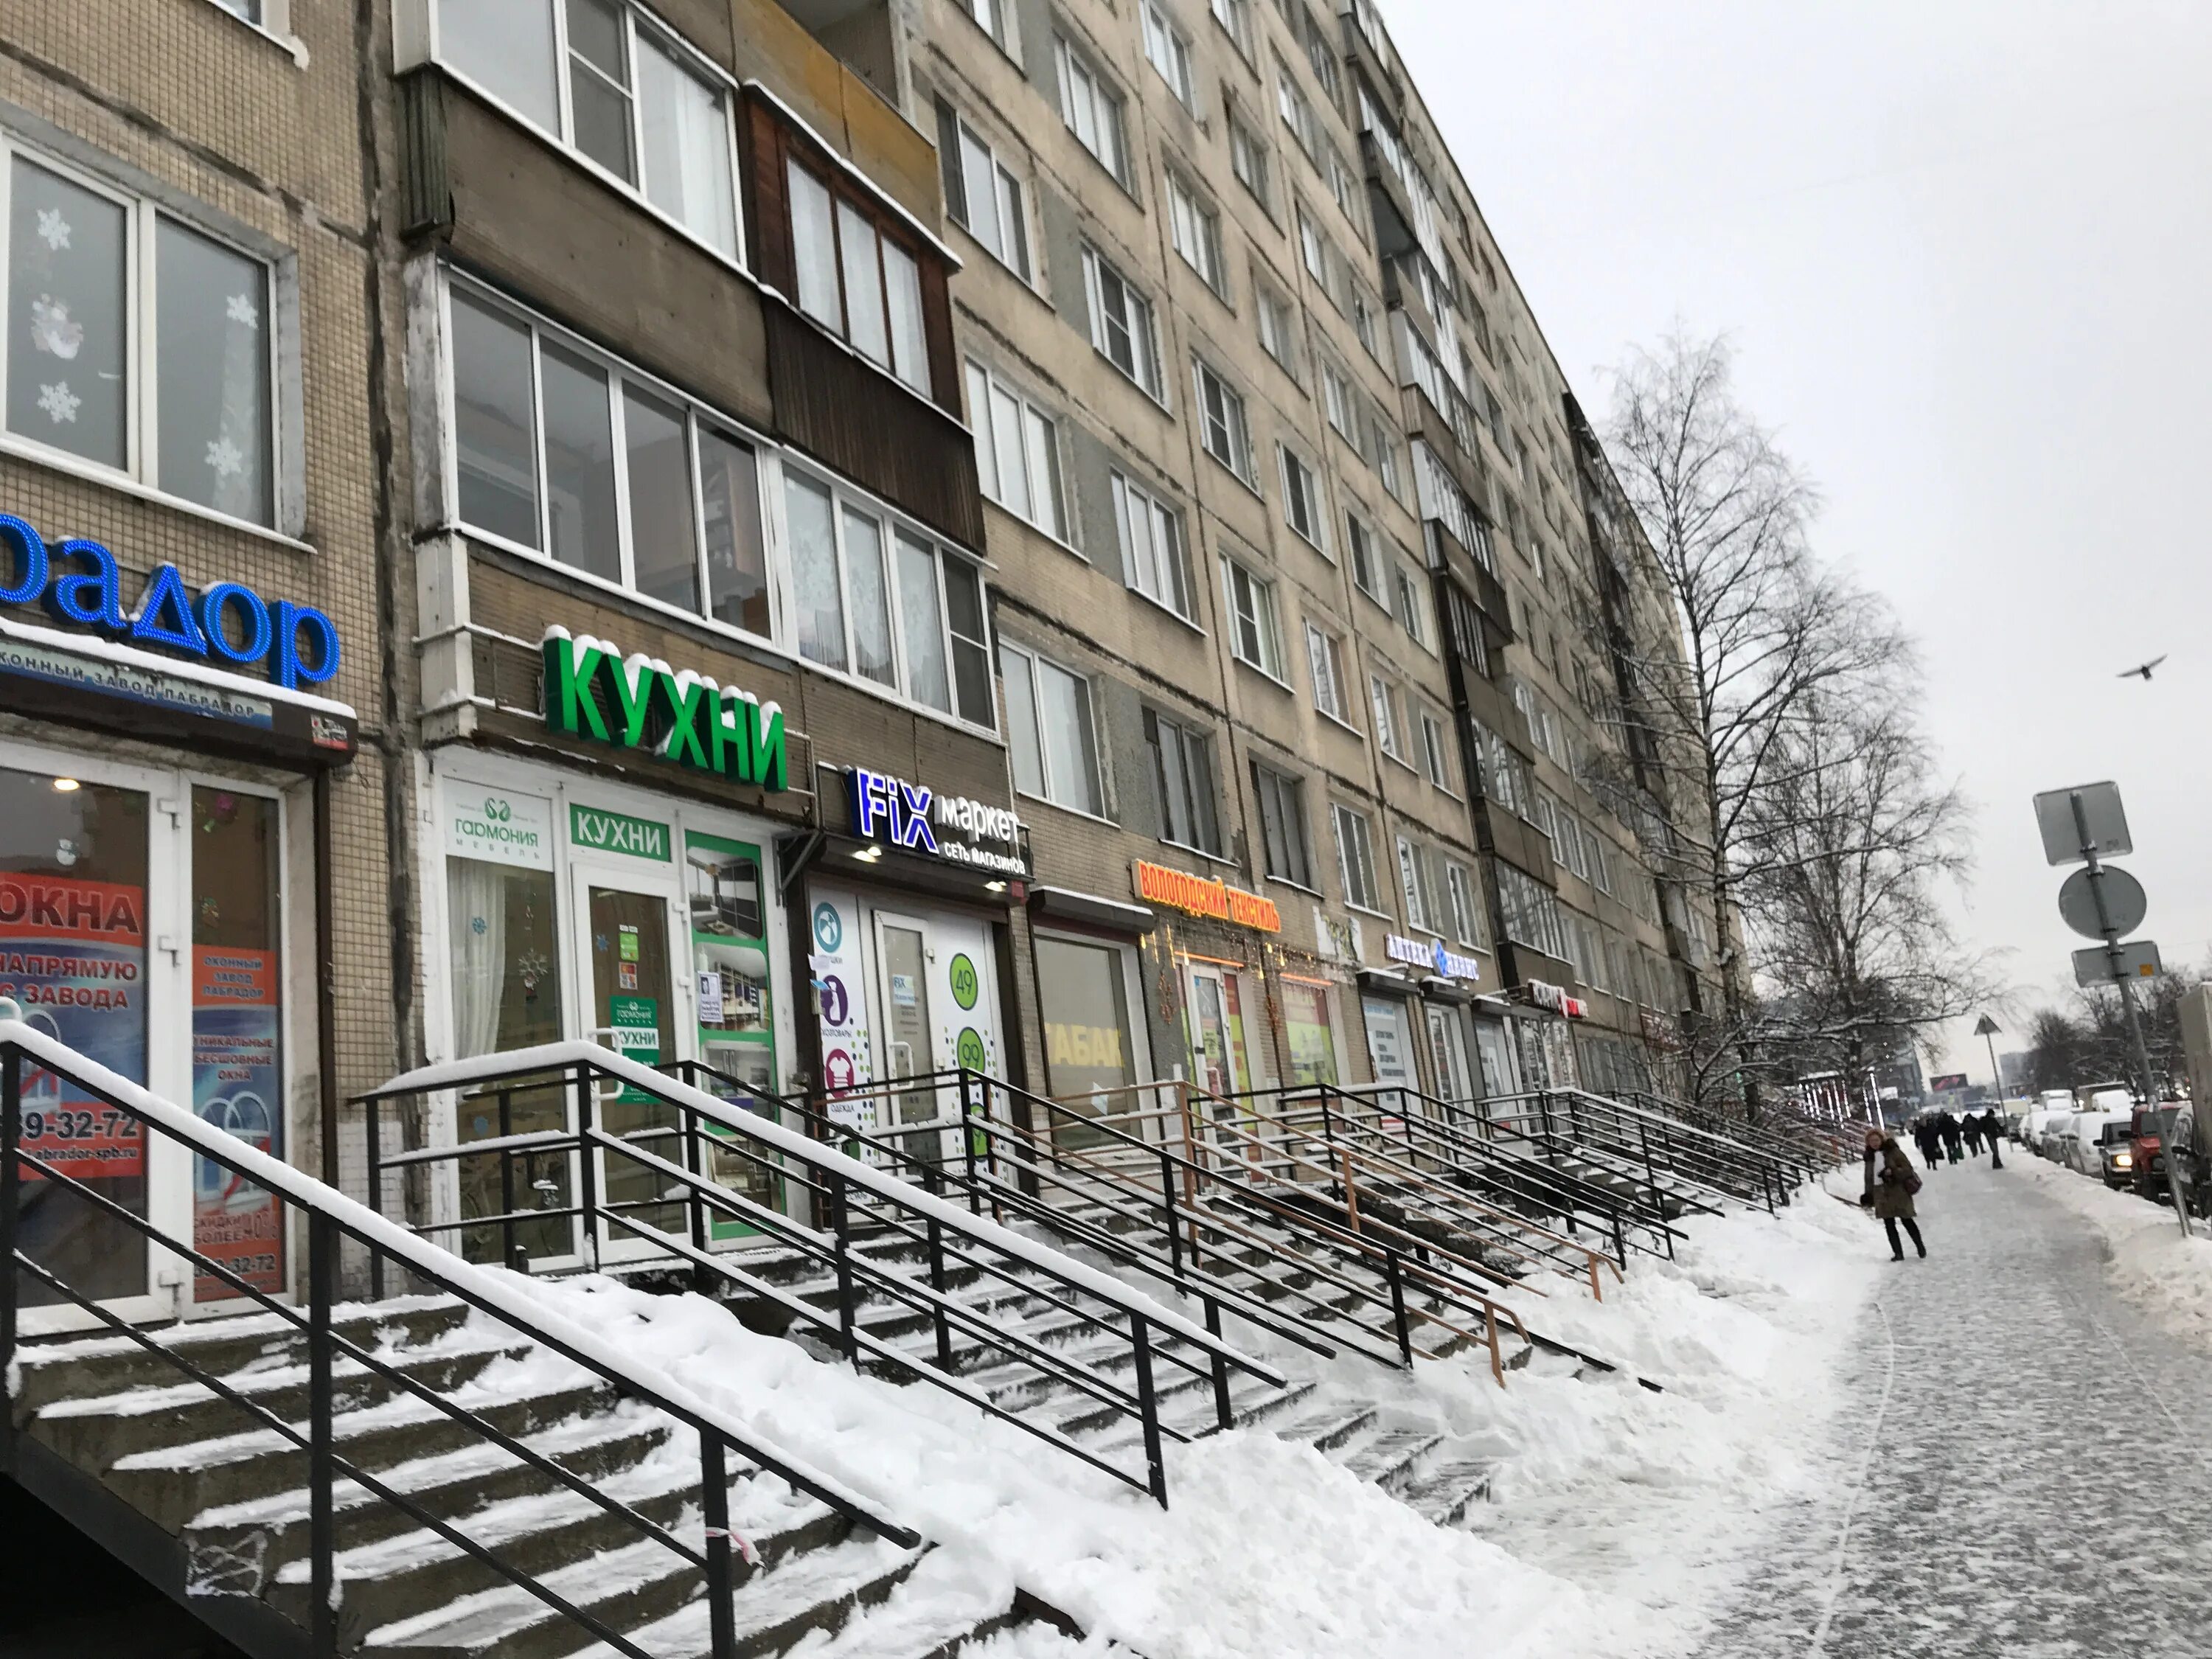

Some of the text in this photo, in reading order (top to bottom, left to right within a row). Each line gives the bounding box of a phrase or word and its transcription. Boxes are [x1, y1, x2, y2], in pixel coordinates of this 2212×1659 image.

[94, 671, 156, 698] ЗАВОД
[546, 636, 789, 793] КУХНИ
[577, 811, 662, 856] КУХНИ
[944, 841, 1026, 875] СЕТЬ МАГАЗИНОВ
[0, 881, 140, 935] ОКНА
[24, 983, 130, 1011] ЗАВОДА
[956, 969, 973, 995] 49
[21, 1111, 138, 1140] 9-32-72
